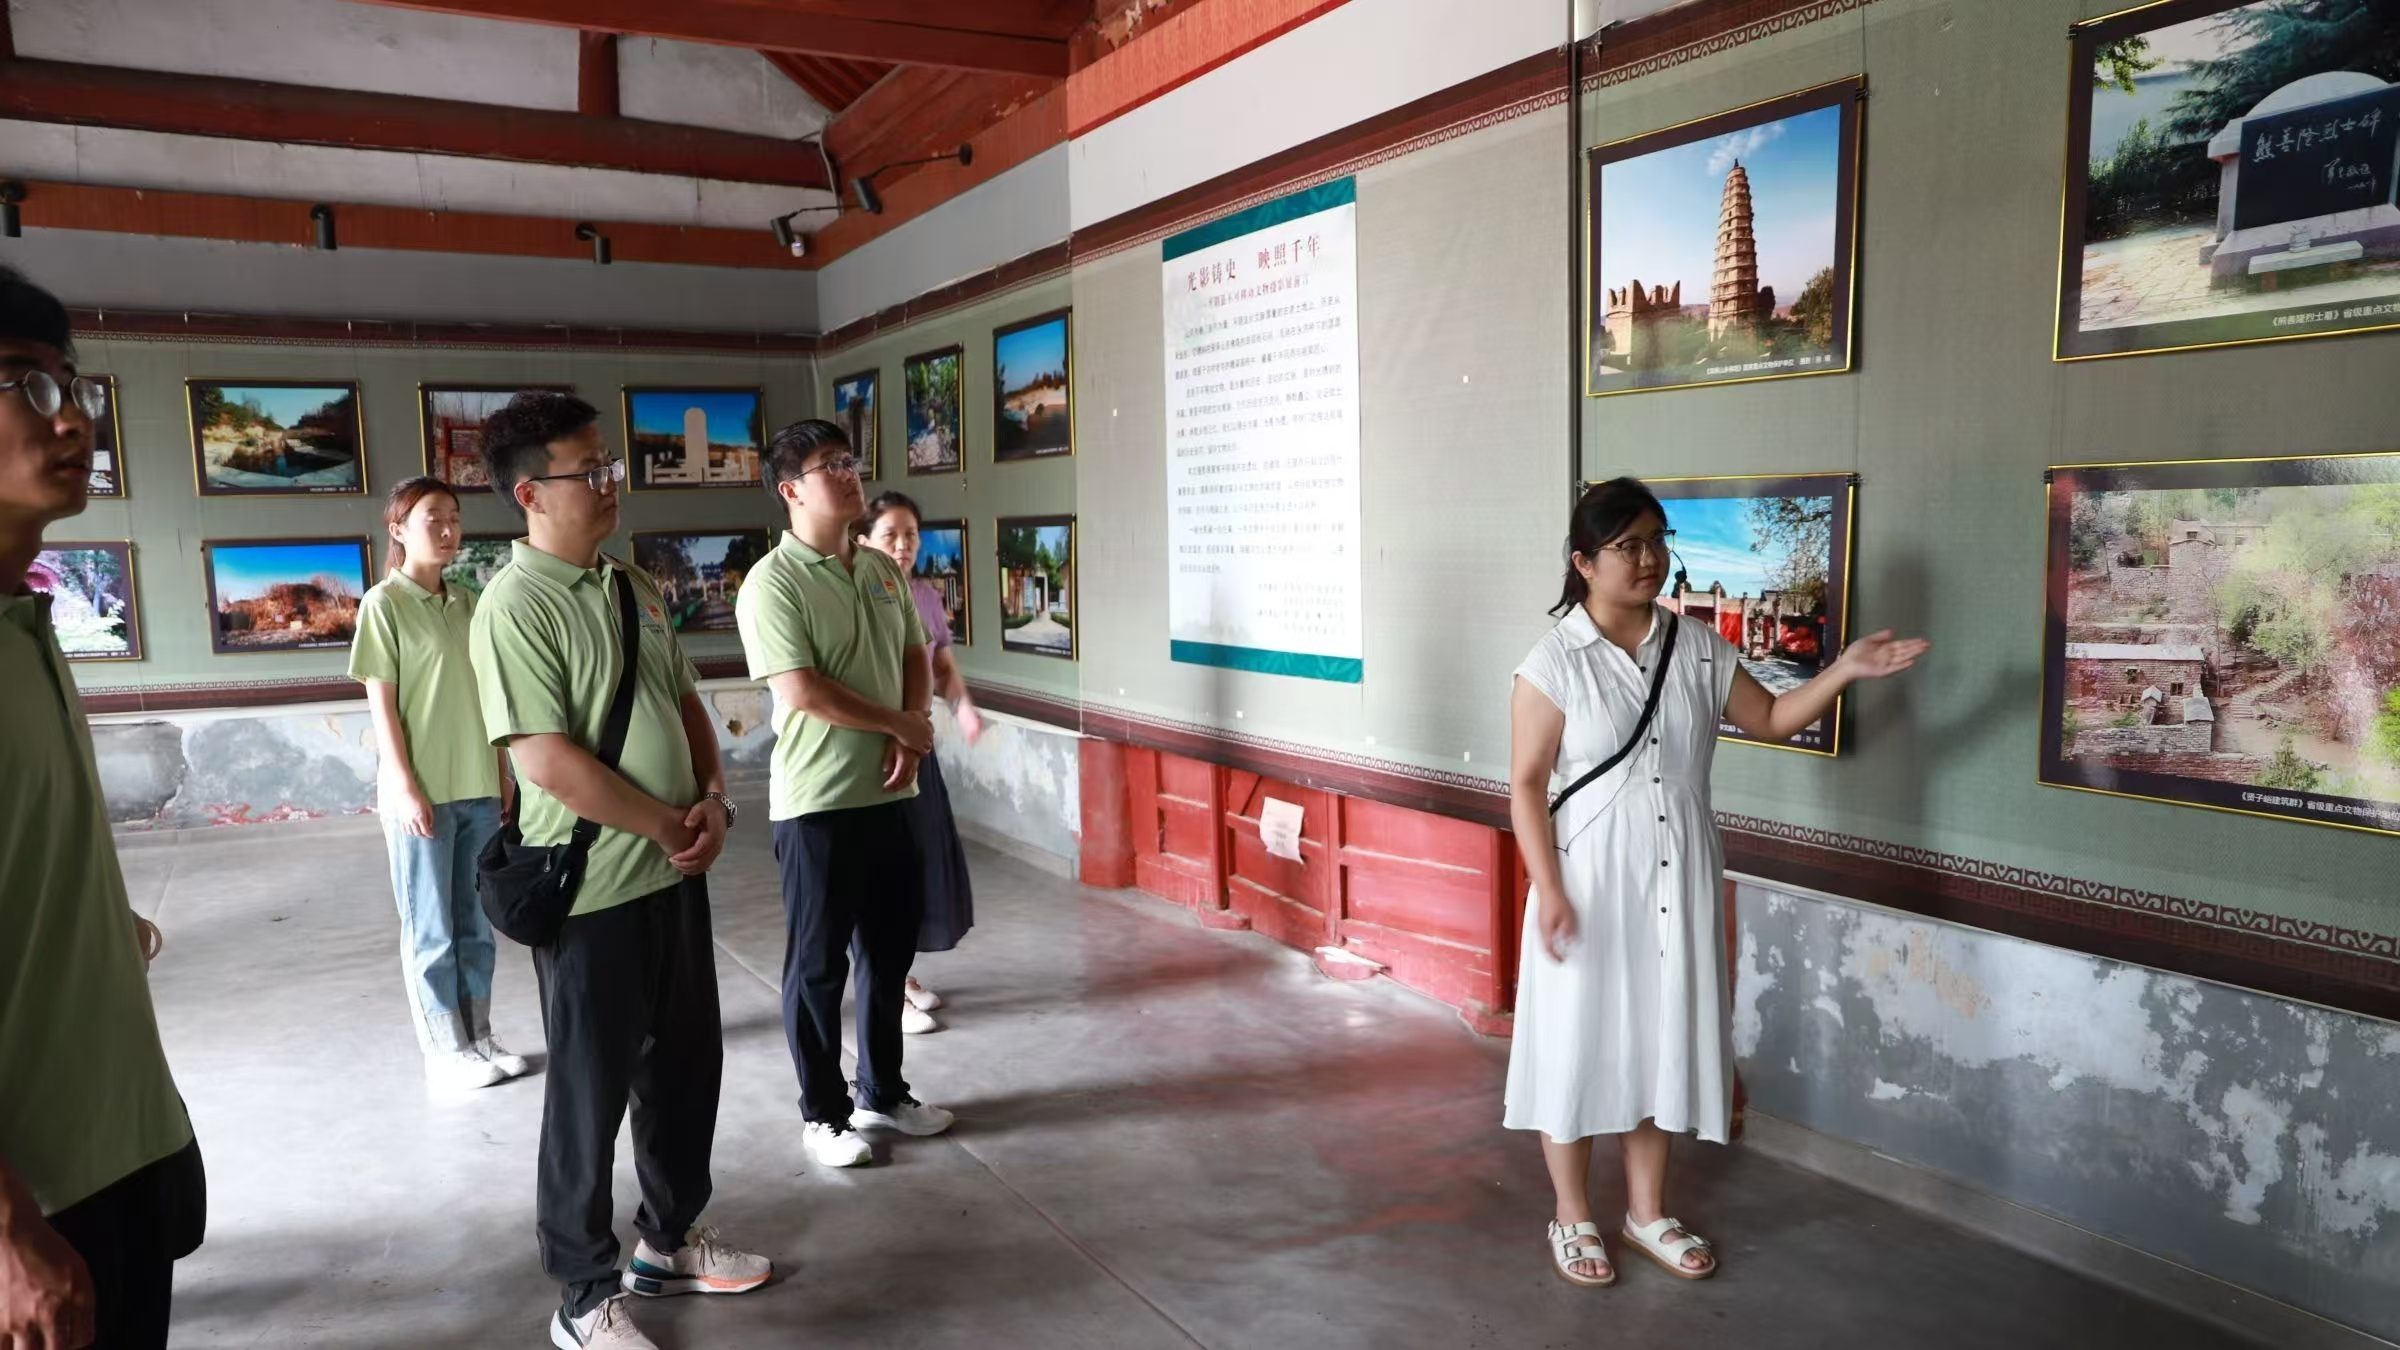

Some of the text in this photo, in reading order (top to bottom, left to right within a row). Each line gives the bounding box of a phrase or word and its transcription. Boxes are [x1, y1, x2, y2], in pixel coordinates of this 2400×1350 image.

[1187, 234, 1320, 292] 光影铸史 映照千年
